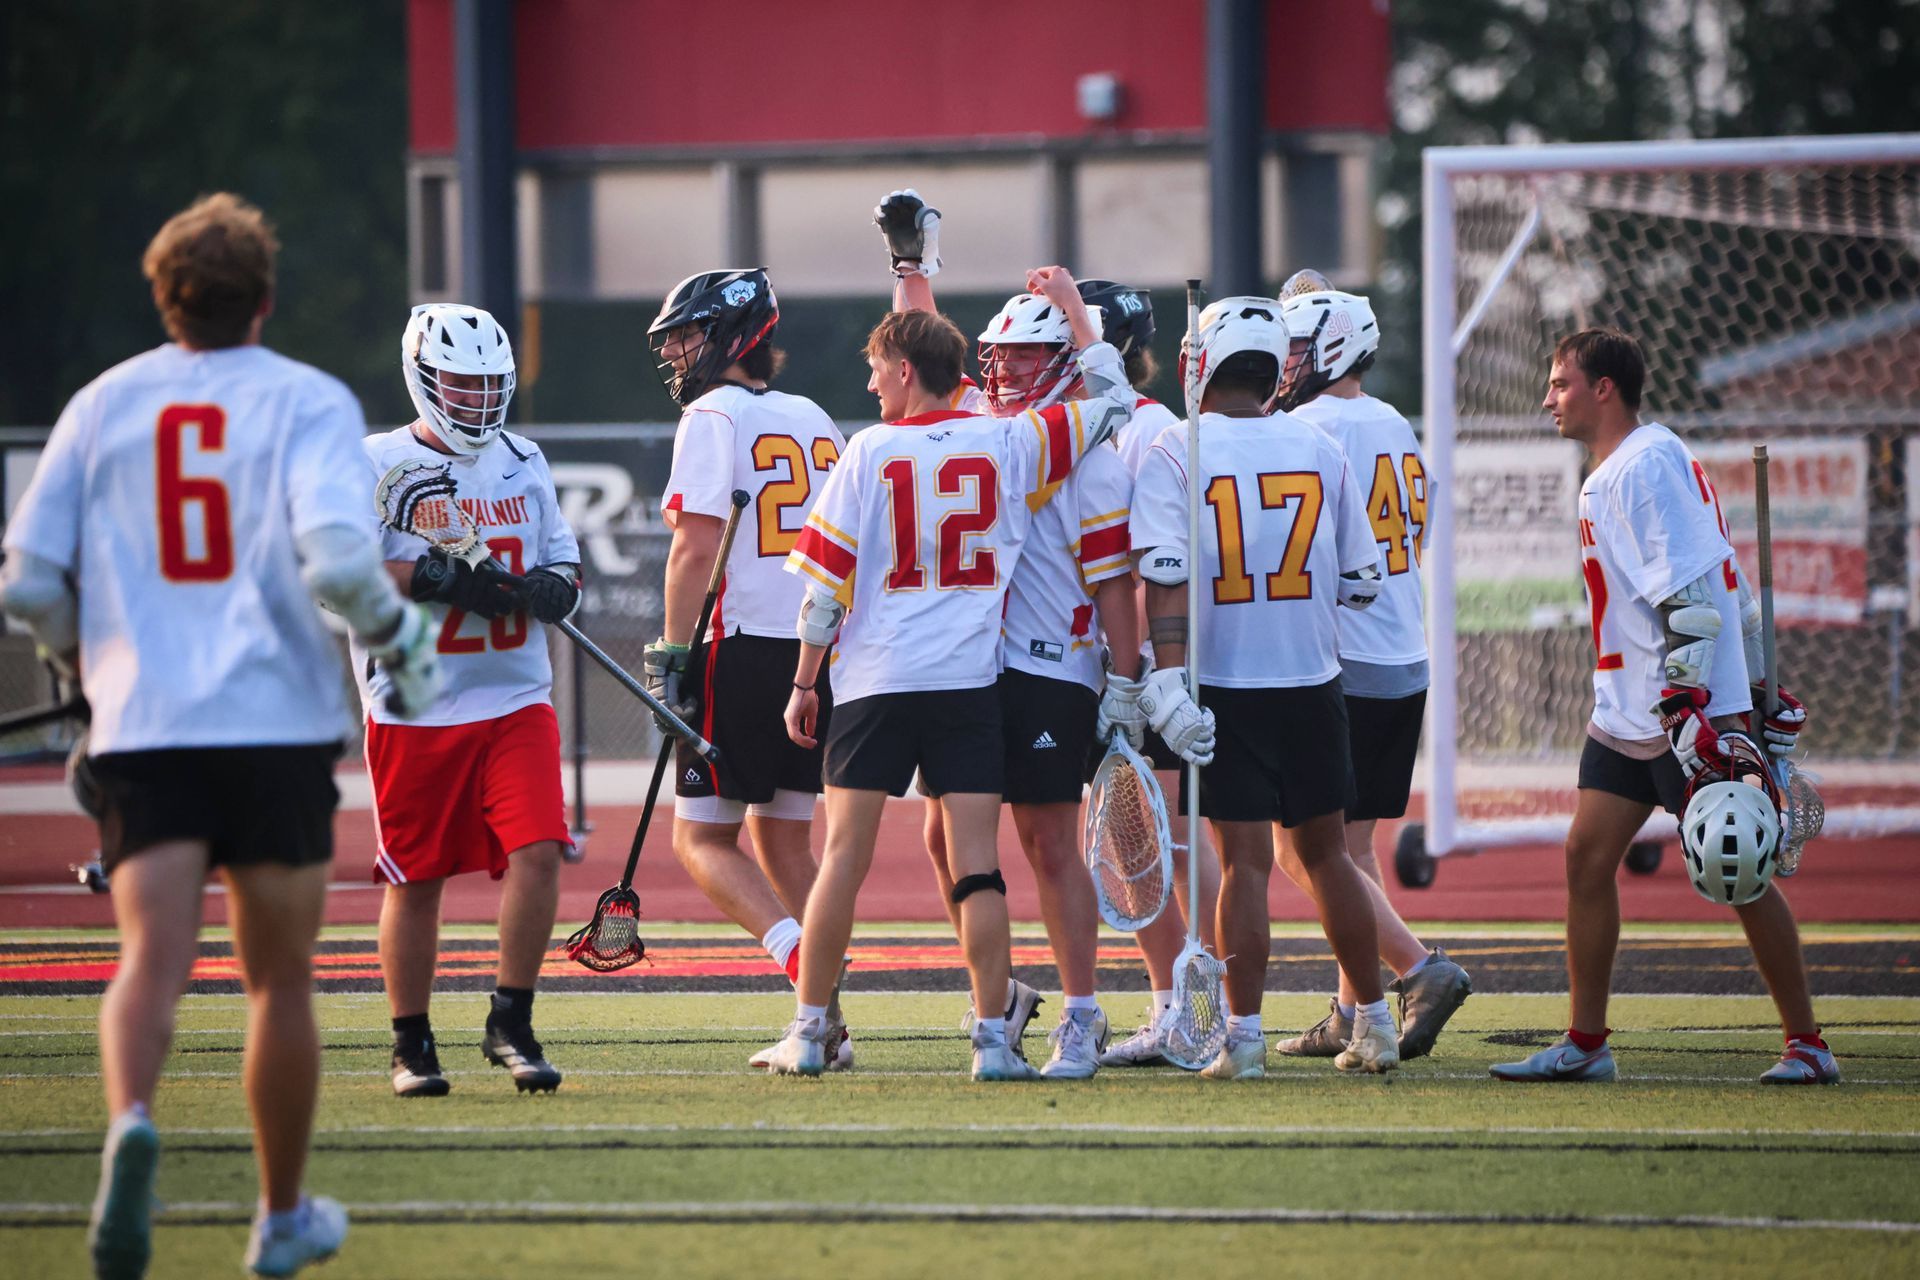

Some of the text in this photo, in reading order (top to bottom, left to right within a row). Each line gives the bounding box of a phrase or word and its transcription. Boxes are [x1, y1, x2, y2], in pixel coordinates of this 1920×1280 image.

[1327, 311, 1353, 337] 30
[156, 404, 235, 583] 6
[457, 495, 529, 528] WALNUT
[880, 452, 1001, 592] 12
[1366, 453, 1428, 577] 49
[1153, 557, 1183, 568] STX
[1204, 470, 1324, 605] 17
[1033, 741, 1057, 749] adidas
